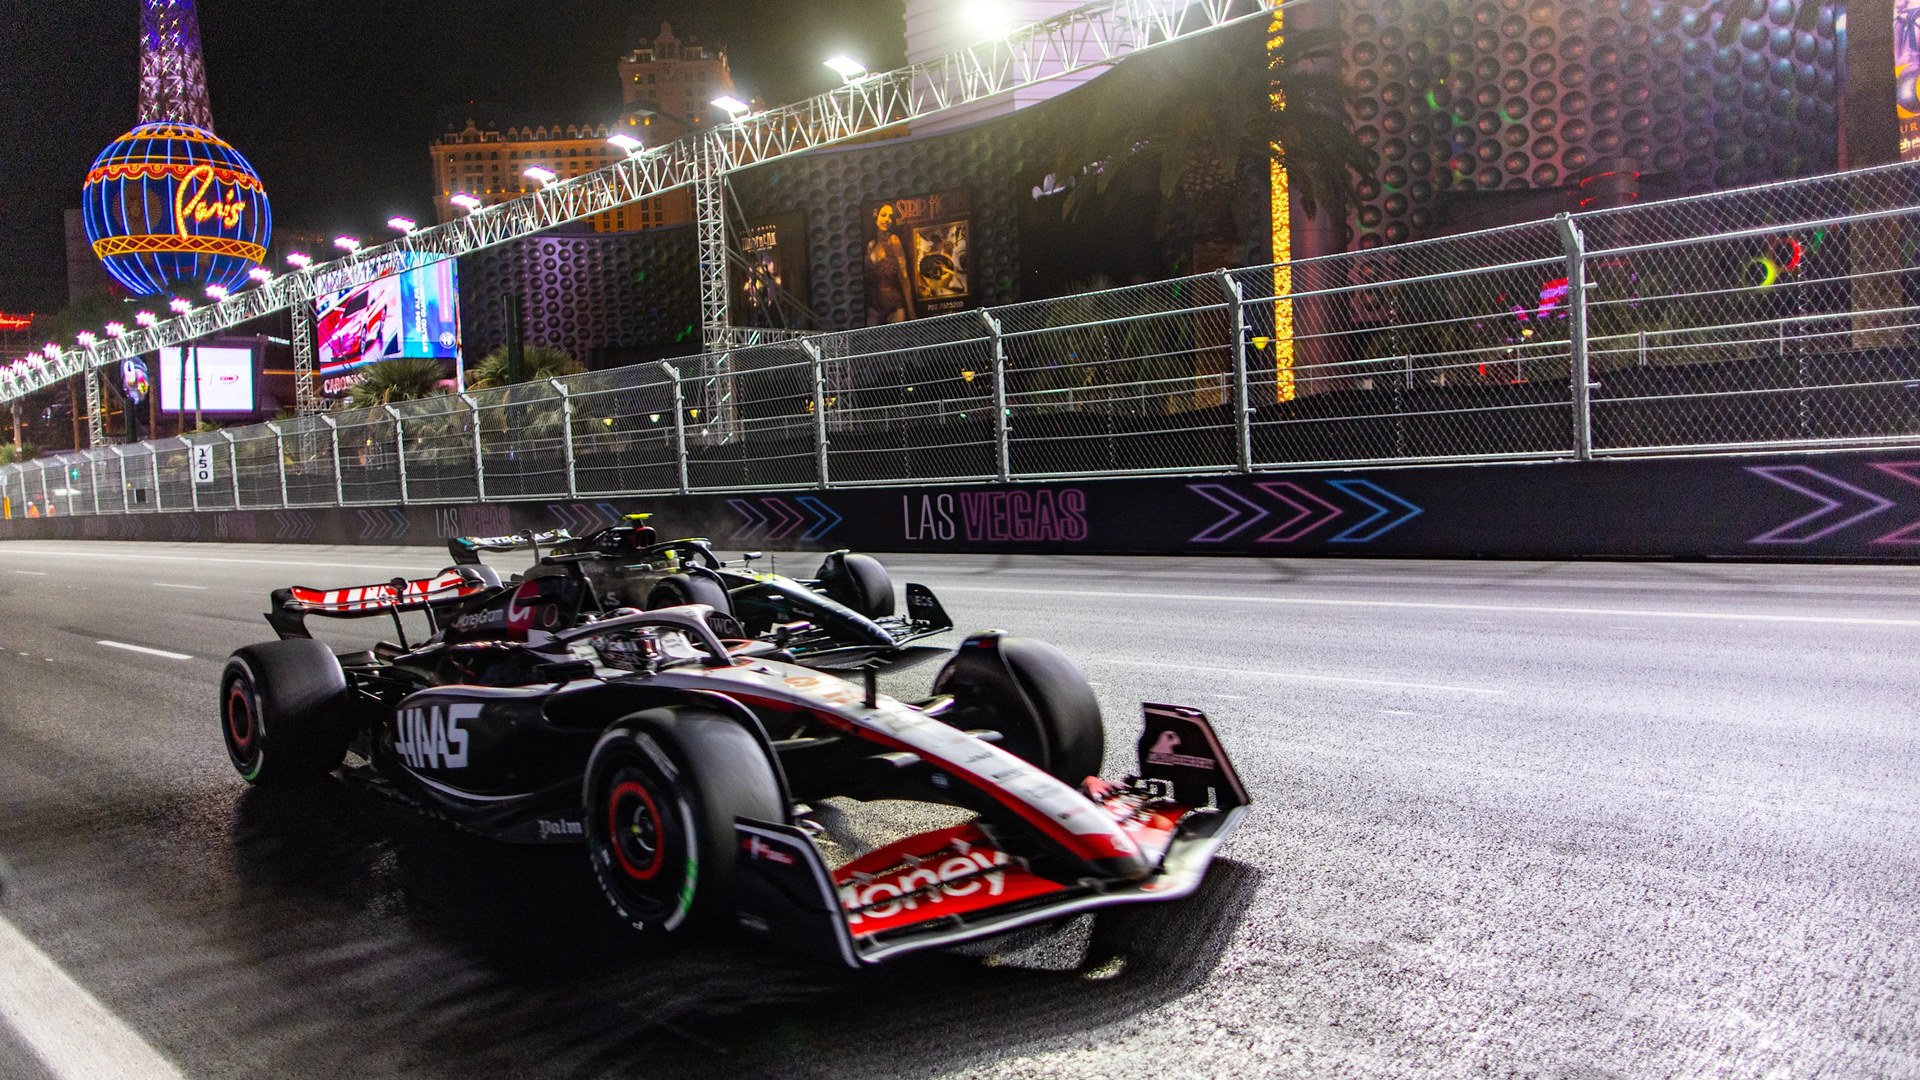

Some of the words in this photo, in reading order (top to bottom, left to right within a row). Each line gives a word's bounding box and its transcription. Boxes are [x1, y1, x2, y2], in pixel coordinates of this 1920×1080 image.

[176, 164, 246, 240] Paris
[199, 448, 208, 480] 150
[435, 507, 459, 538] LAS
[459, 505, 512, 538] VEGAS
[903, 494, 955, 540] LAS
[960, 488, 1088, 542] VEGAS
[395, 703, 485, 768] HAAS
